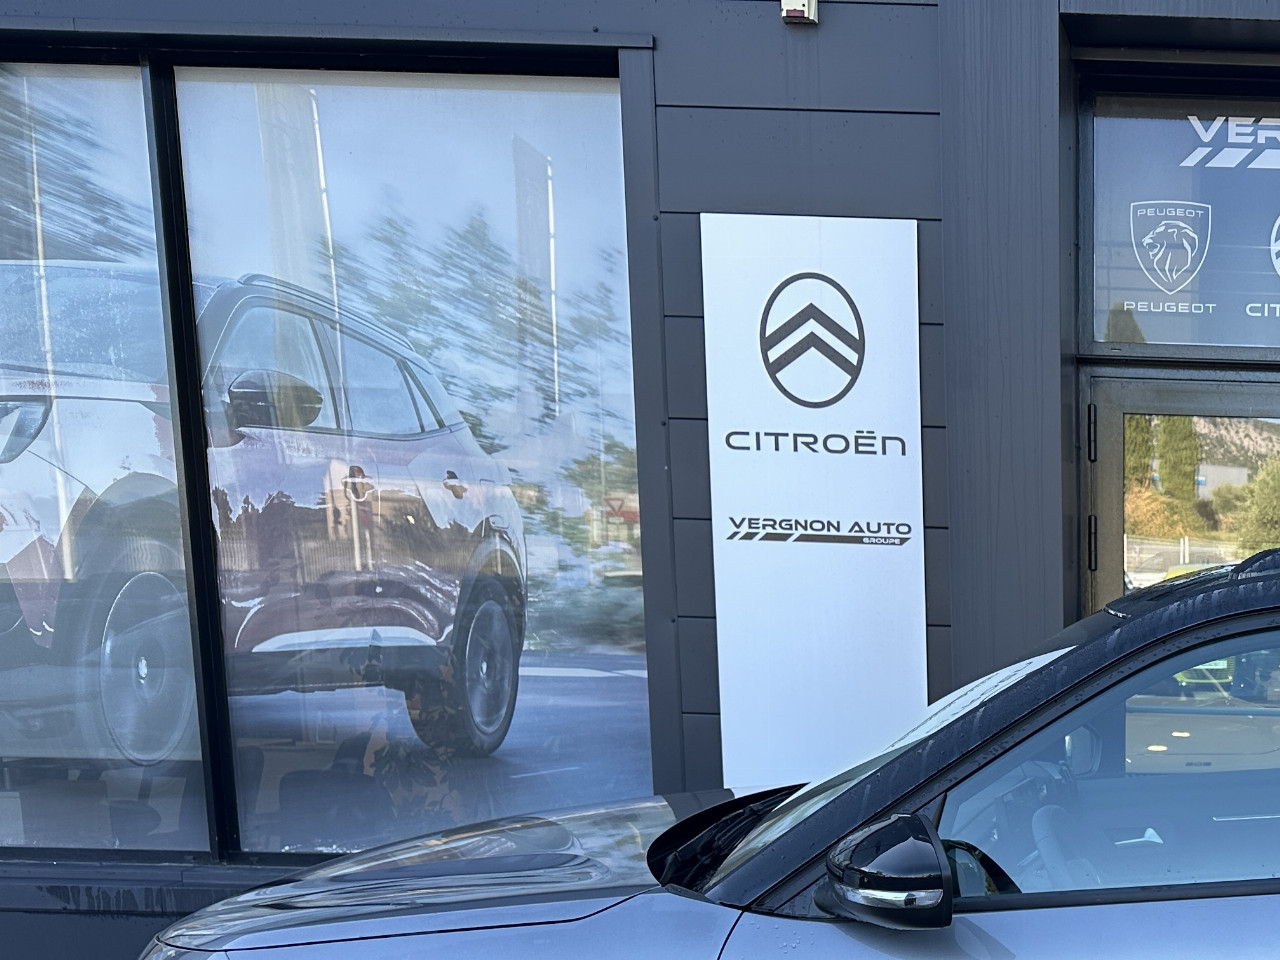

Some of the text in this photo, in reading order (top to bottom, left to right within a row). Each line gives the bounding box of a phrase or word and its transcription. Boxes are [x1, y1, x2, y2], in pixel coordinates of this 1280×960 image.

[1137, 208, 1204, 218] PEUGEOT
[1123, 301, 1217, 314] PEUGEOT
[728, 517, 912, 535] VERGNON AUTO
[862, 537, 901, 545] GROUPE
